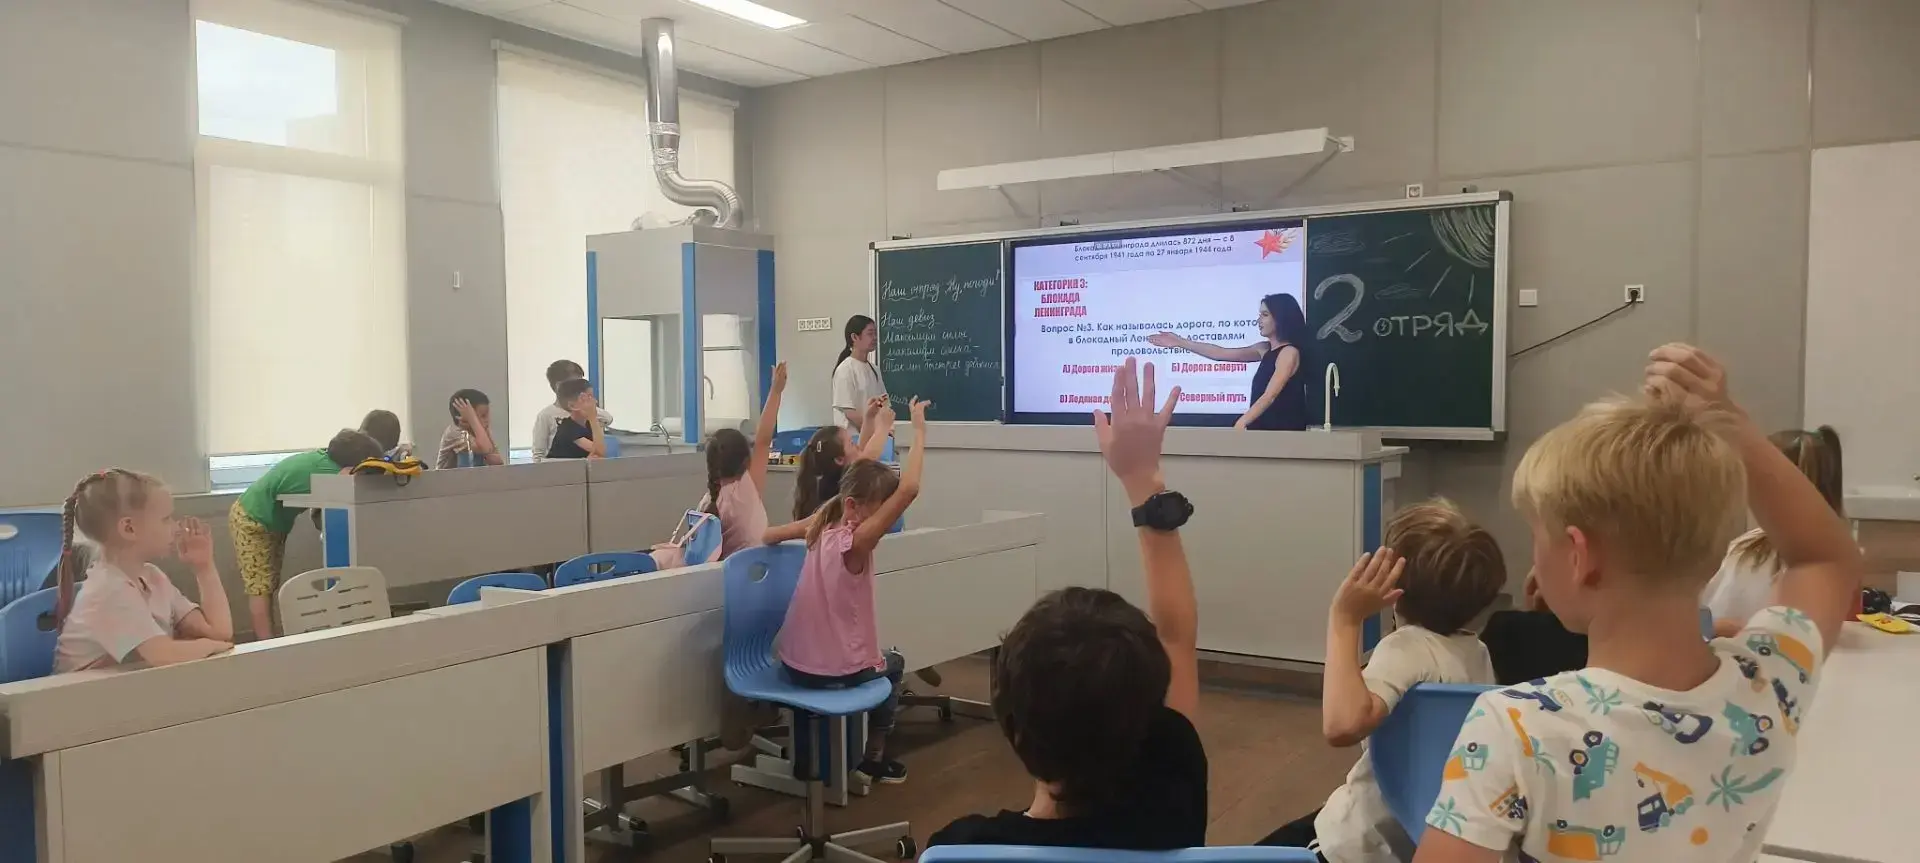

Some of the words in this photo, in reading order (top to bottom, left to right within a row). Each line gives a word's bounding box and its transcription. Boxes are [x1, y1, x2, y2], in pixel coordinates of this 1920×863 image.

[1128, 250, 1144, 259] года
[1167, 248, 1193, 256] января
[1034, 280, 1079, 291] КАТЕГОРИЯ
[1080, 279, 1088, 288] 3:
[1041, 293, 1080, 304] БЛОКАДА
[1034, 306, 1087, 318] ЛЕНИНГРАДА
[1314, 273, 1365, 343] 2
[881, 312, 904, 328] Наш
[908, 308, 936, 330] девиз
[1041, 325, 1074, 334] Вопрос
[1077, 324, 1095, 332] №3.
[1098, 322, 1114, 331] Как
[1116, 320, 1174, 330] называлась
[1176, 320, 1215, 330] дорога,
[883, 331, 936, 344] Максимум
[1076, 334, 1128, 344] блокадный
[1187, 333, 1245, 342] доставляли
[886, 344, 936, 360] максимум
[883, 358, 905, 372] Так
[1063, 364, 1071, 373] А)
[1072, 364, 1099, 374] Дорога
[1172, 363, 1180, 372] Б)
[1182, 363, 1212, 373] Дорога
[1214, 363, 1247, 372] смерти
[1060, 395, 1068, 403] В)
[1069, 395, 1103, 404] Ледяная
[1180, 393, 1225, 402] Северный
[1227, 393, 1247, 402] путь
